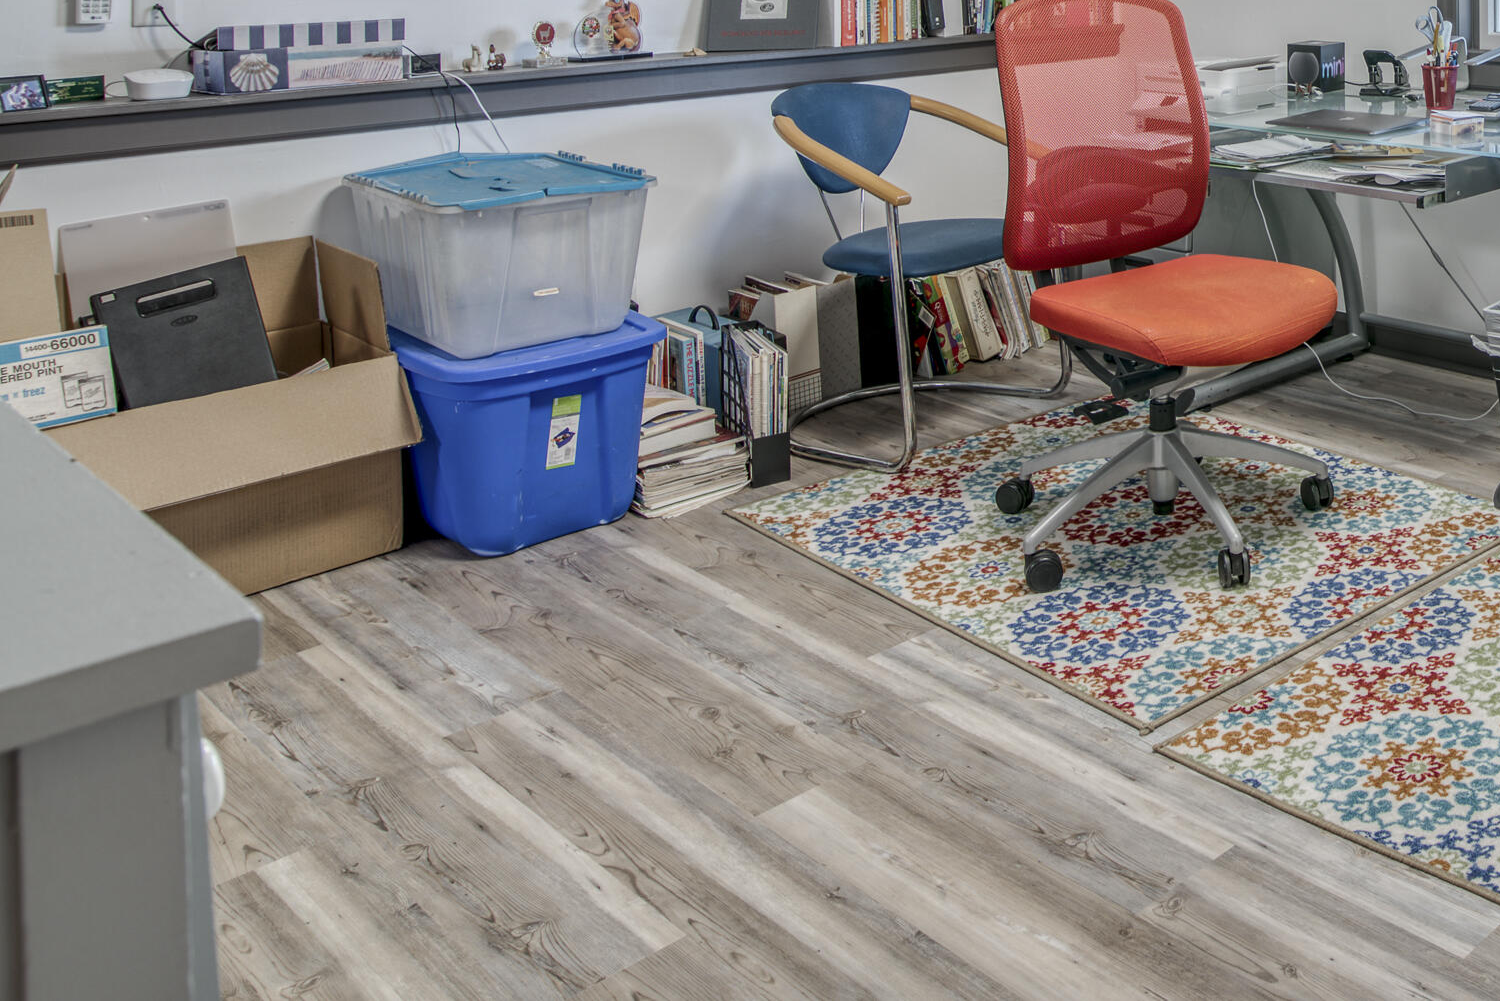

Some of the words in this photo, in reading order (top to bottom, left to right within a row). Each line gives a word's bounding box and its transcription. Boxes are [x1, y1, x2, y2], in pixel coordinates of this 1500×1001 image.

[1322, 56, 1345, 78] mini
[13, 359, 57, 373] MOUTH
[37, 365, 63, 377] PINT
